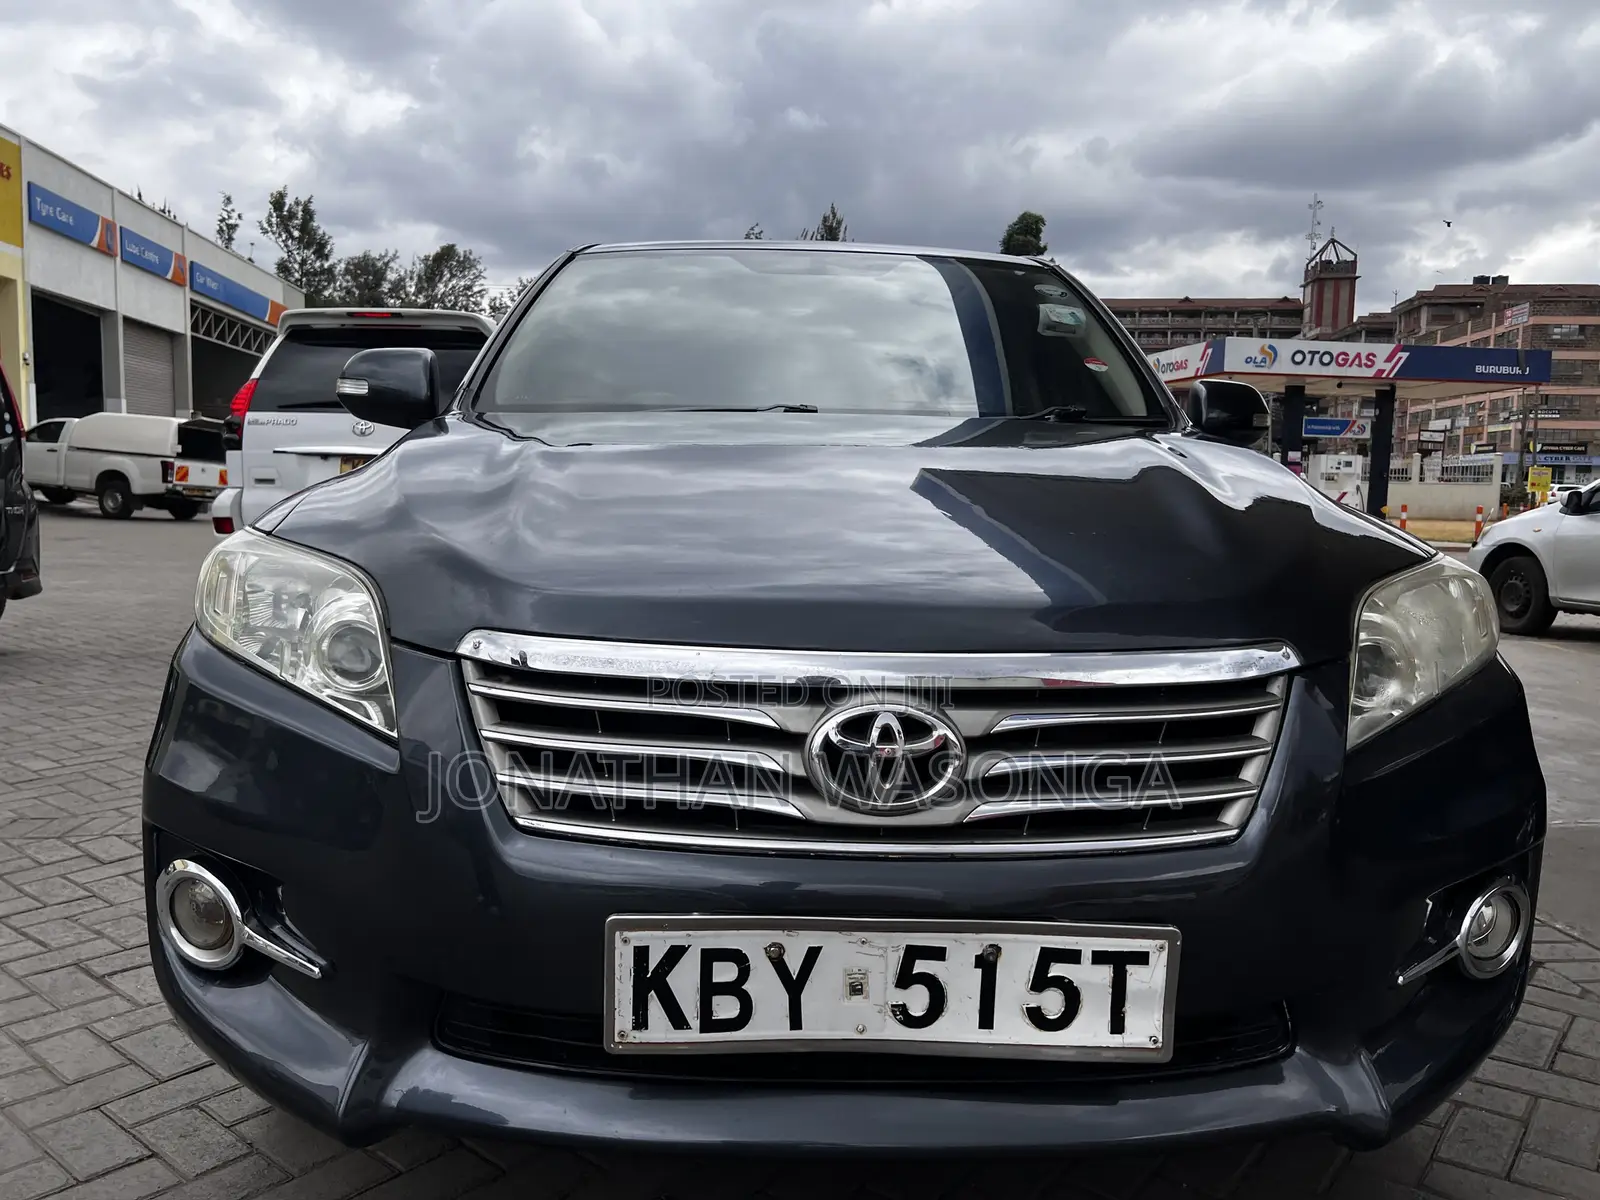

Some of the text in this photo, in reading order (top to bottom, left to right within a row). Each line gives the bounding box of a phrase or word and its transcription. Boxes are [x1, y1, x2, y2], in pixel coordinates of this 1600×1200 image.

[36, 196, 75, 226] Tyre Care
[1160, 359, 1188, 374] OTOGAS
[1244, 356, 1267, 365] OLA
[1291, 349, 1377, 368] OTOGAS
[631, 944, 1150, 1036] KBY 515T
